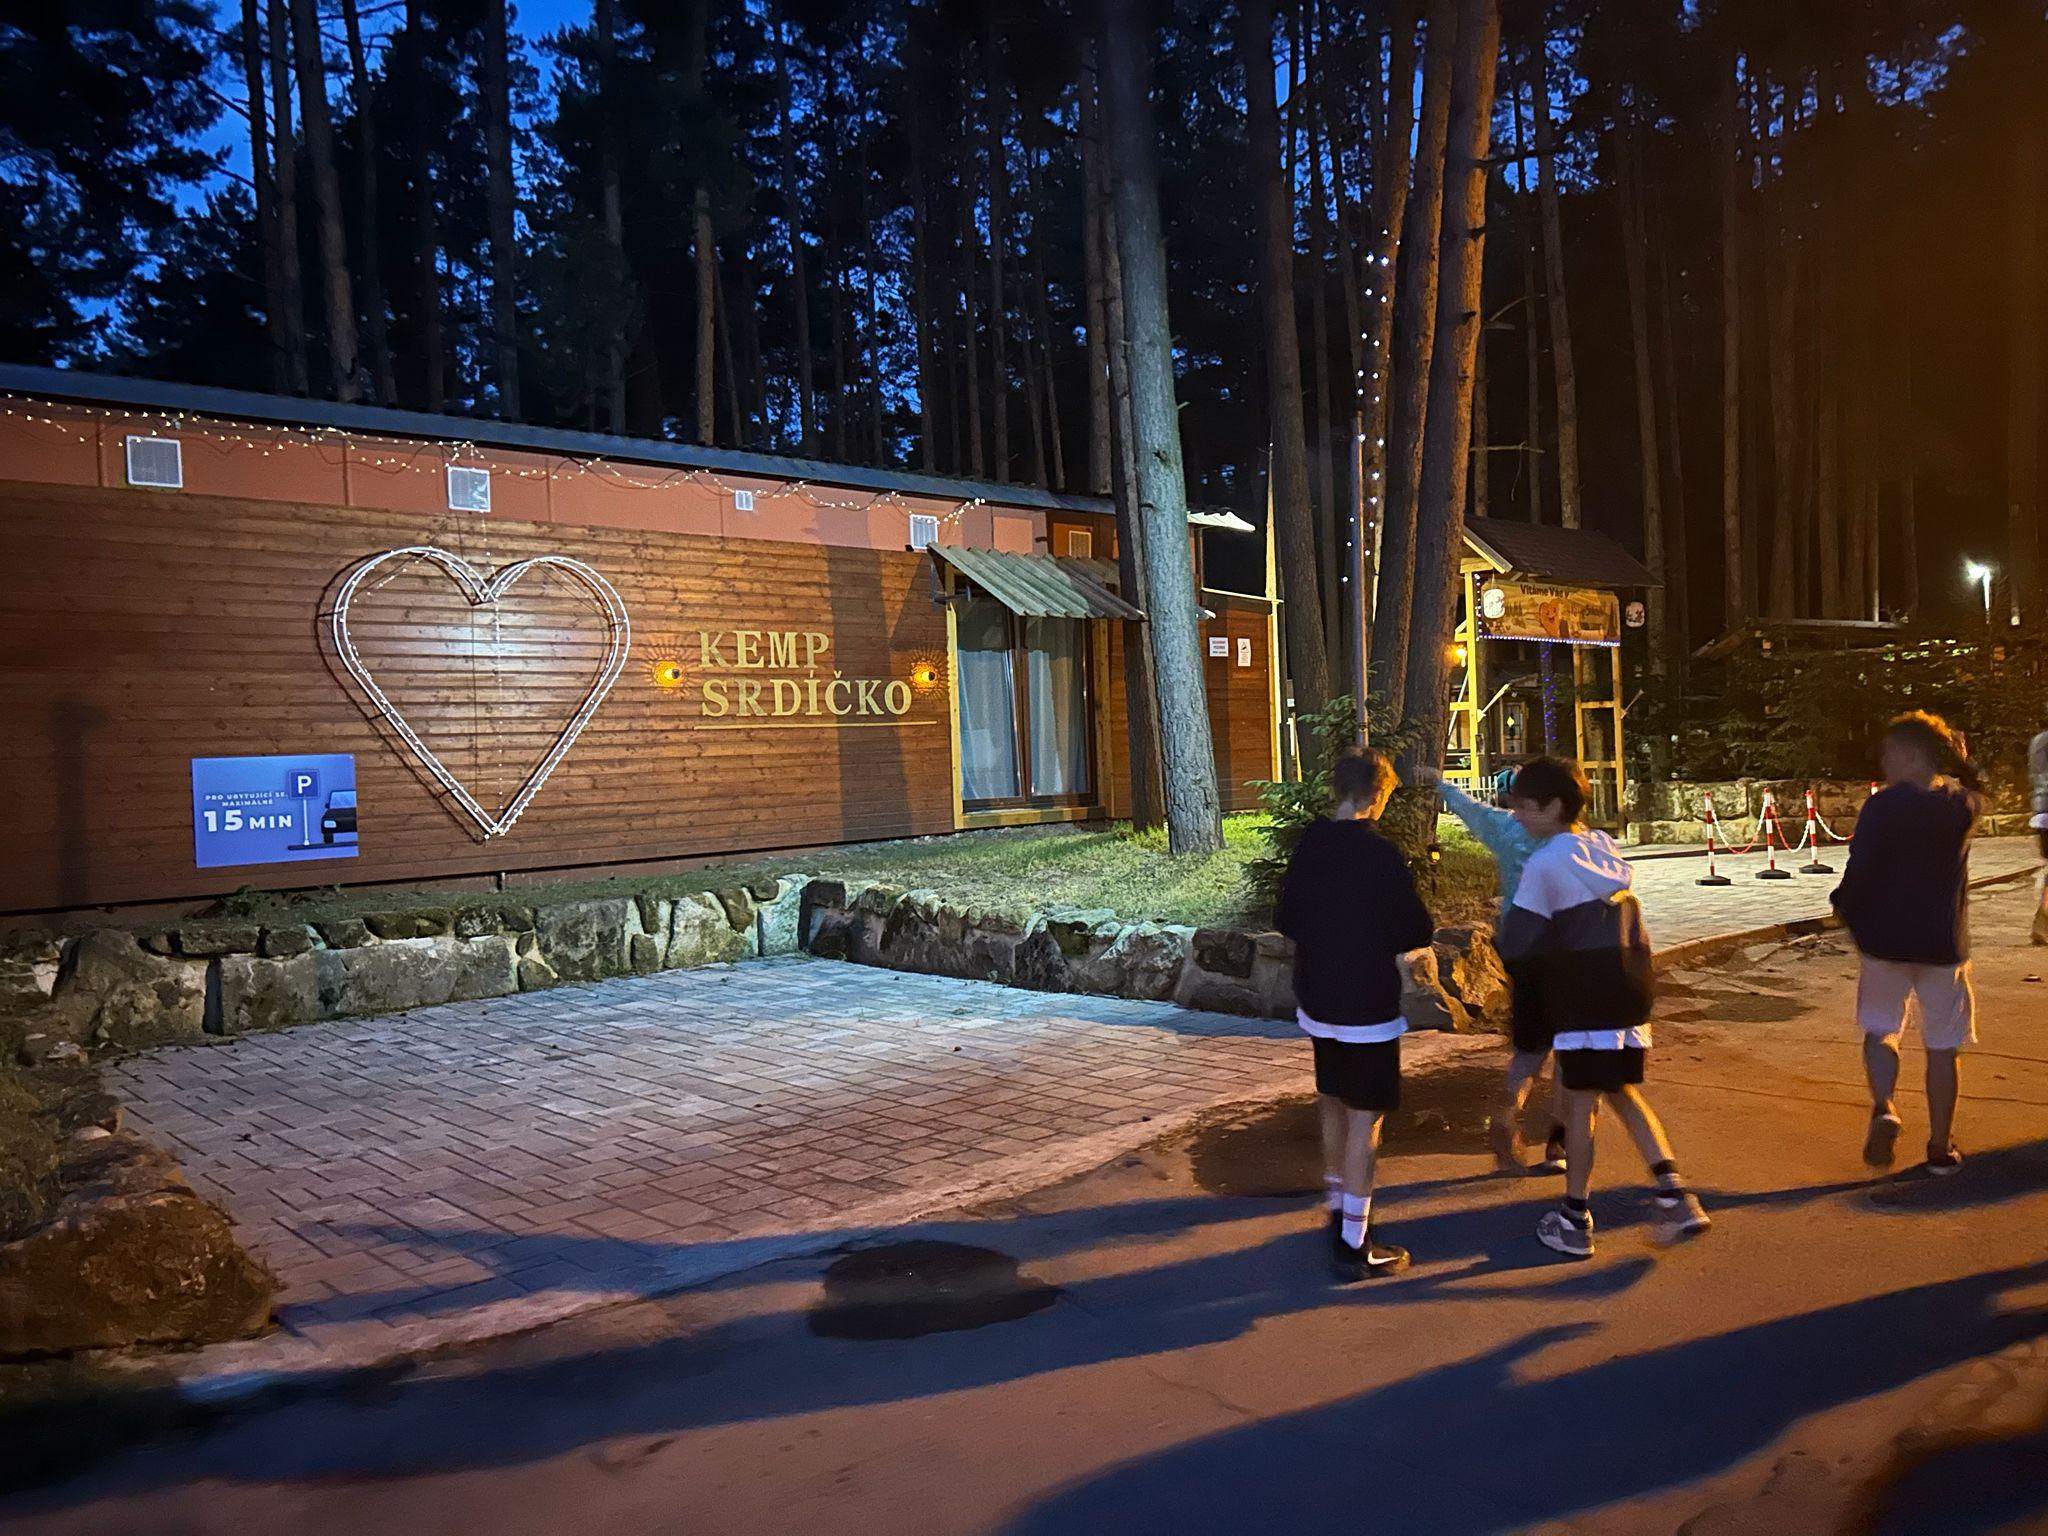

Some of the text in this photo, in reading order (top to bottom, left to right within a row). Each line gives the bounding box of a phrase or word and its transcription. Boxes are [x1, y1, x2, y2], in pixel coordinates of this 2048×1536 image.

[700, 630, 829, 669] KEMP
[701, 669, 912, 717] SRDÍČKO
[297, 775, 312, 794] P
[203, 809, 292, 832] 15 MIN
